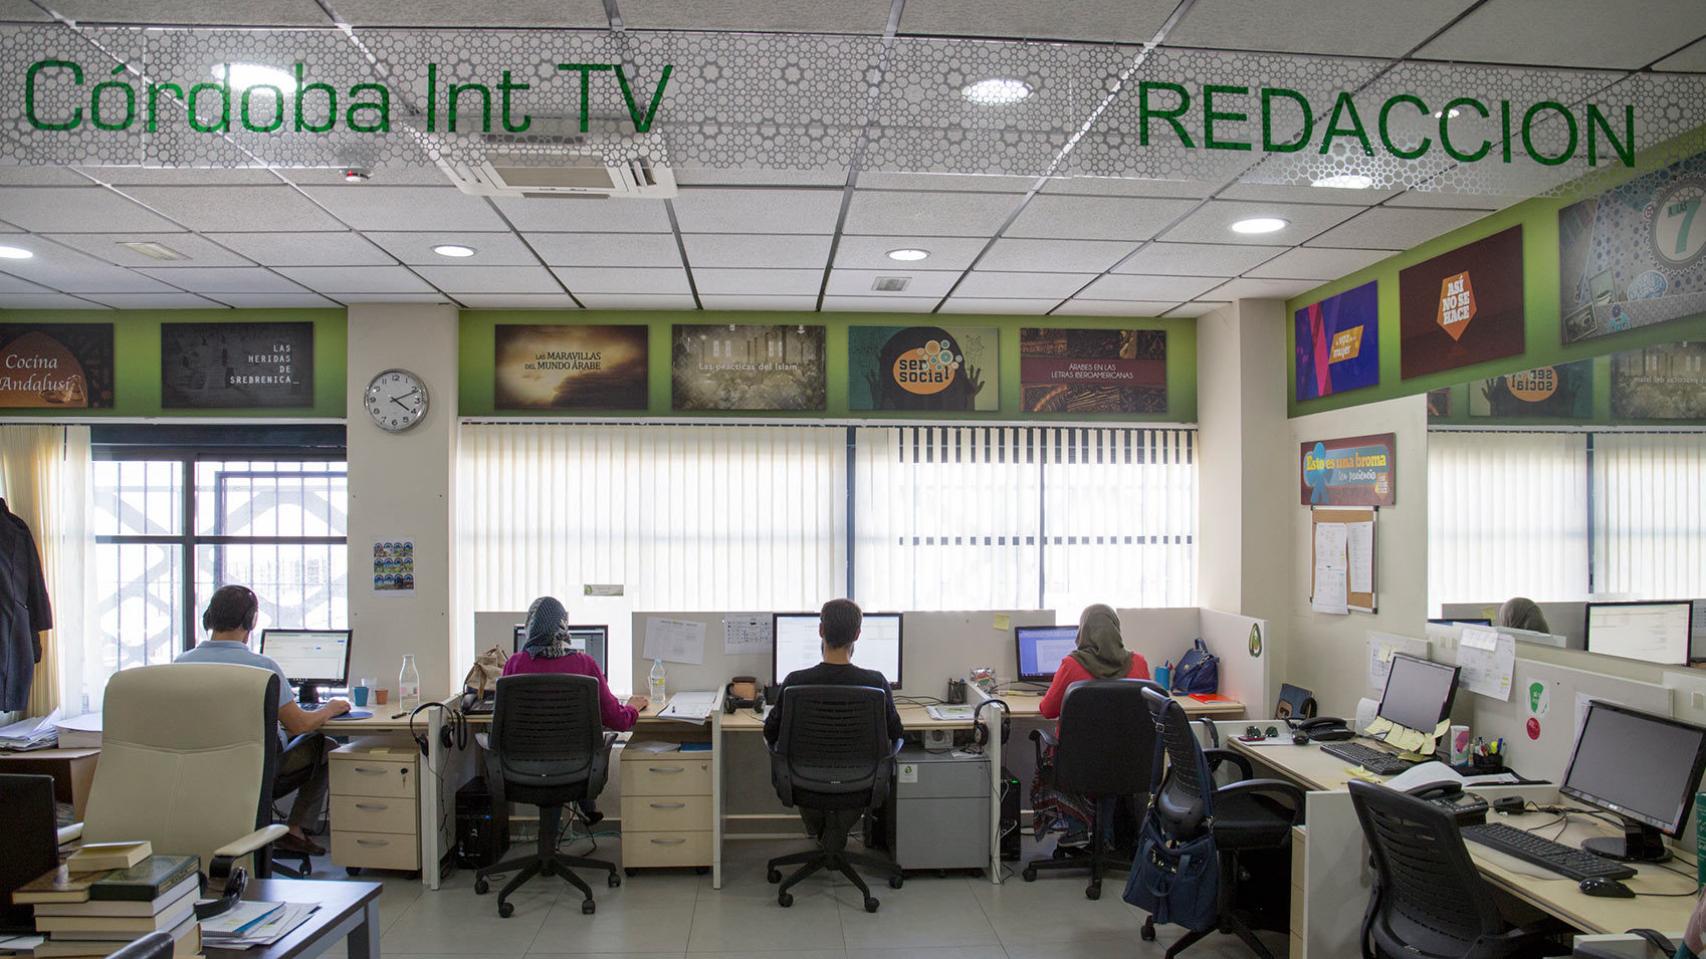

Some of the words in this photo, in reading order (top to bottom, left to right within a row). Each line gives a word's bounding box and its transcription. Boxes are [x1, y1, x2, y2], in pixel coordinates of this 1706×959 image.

[26, 60, 390, 133] Córdoba
[426, 63, 531, 133] Int
[558, 64, 674, 133] TV
[1138, 80, 1636, 168] REDACCION
[1667, 197, 1702, 255] 7
[1447, 273, 1464, 296] ASÍ
[1442, 295, 1457, 312] NO
[1457, 290, 1470, 307] SE
[1443, 305, 1470, 325] HACE
[273, 344, 291, 352] LAS
[546, 351, 601, 361] MARAVILLAS
[5, 353, 59, 369] Cocina
[248, 354, 291, 363] HERIDAS
[537, 361, 571, 370] MUNDO
[571, 359, 601, 370] ÁRABE
[899, 359, 928, 370] ser
[279, 366, 291, 374] DE
[899, 366, 949, 383] social
[1051, 371, 1074, 379] LETRAS
[1074, 371, 1134, 379] IBEROAMERICANAS
[1093, 363, 1103, 371] EN
[1104, 363, 1117, 371] LAS
[1306, 454, 1325, 471] Esto
[1325, 458, 1336, 470] es
[1336, 456, 1354, 469] una
[1355, 451, 1387, 468] broma
